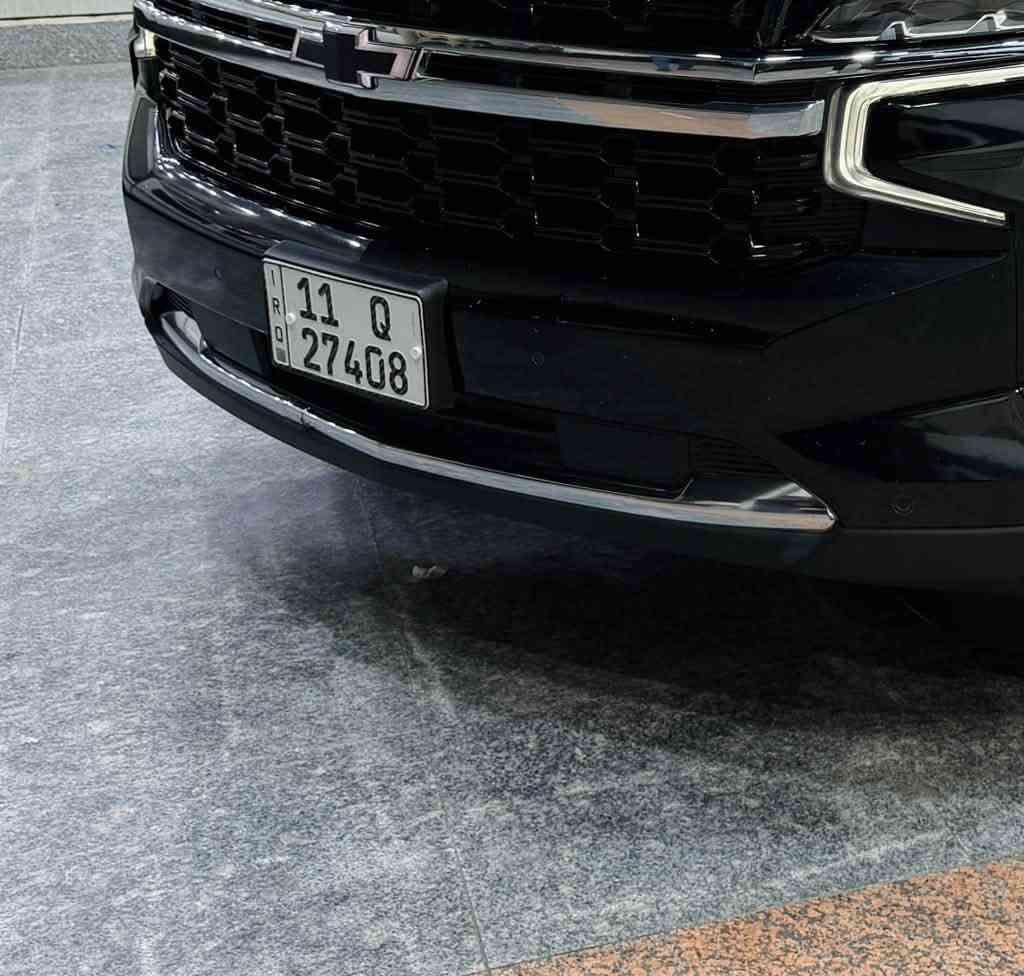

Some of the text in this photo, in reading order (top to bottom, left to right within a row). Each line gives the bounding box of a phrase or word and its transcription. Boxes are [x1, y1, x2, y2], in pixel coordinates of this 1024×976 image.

[297, 276, 392, 342] 11 Q
[301, 327, 409, 396] 27408
